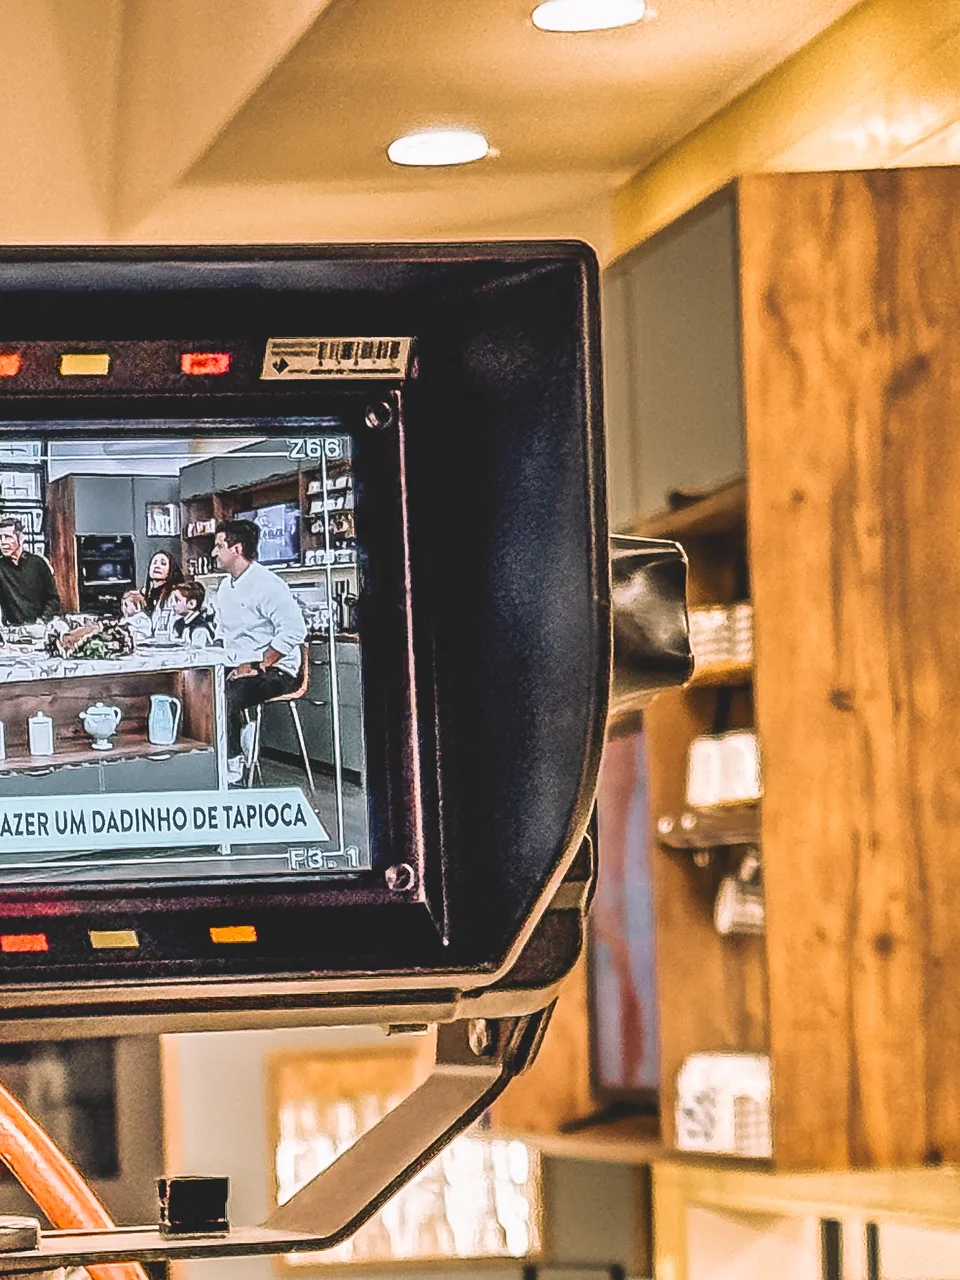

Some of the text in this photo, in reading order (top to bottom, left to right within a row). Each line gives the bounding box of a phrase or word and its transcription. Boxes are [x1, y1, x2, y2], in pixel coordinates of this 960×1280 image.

[55, 809, 87, 835] UM
[92, 806, 187, 834] DADINHO
[193, 806, 218, 829] DE
[222, 803, 307, 830] TAPIOCA
